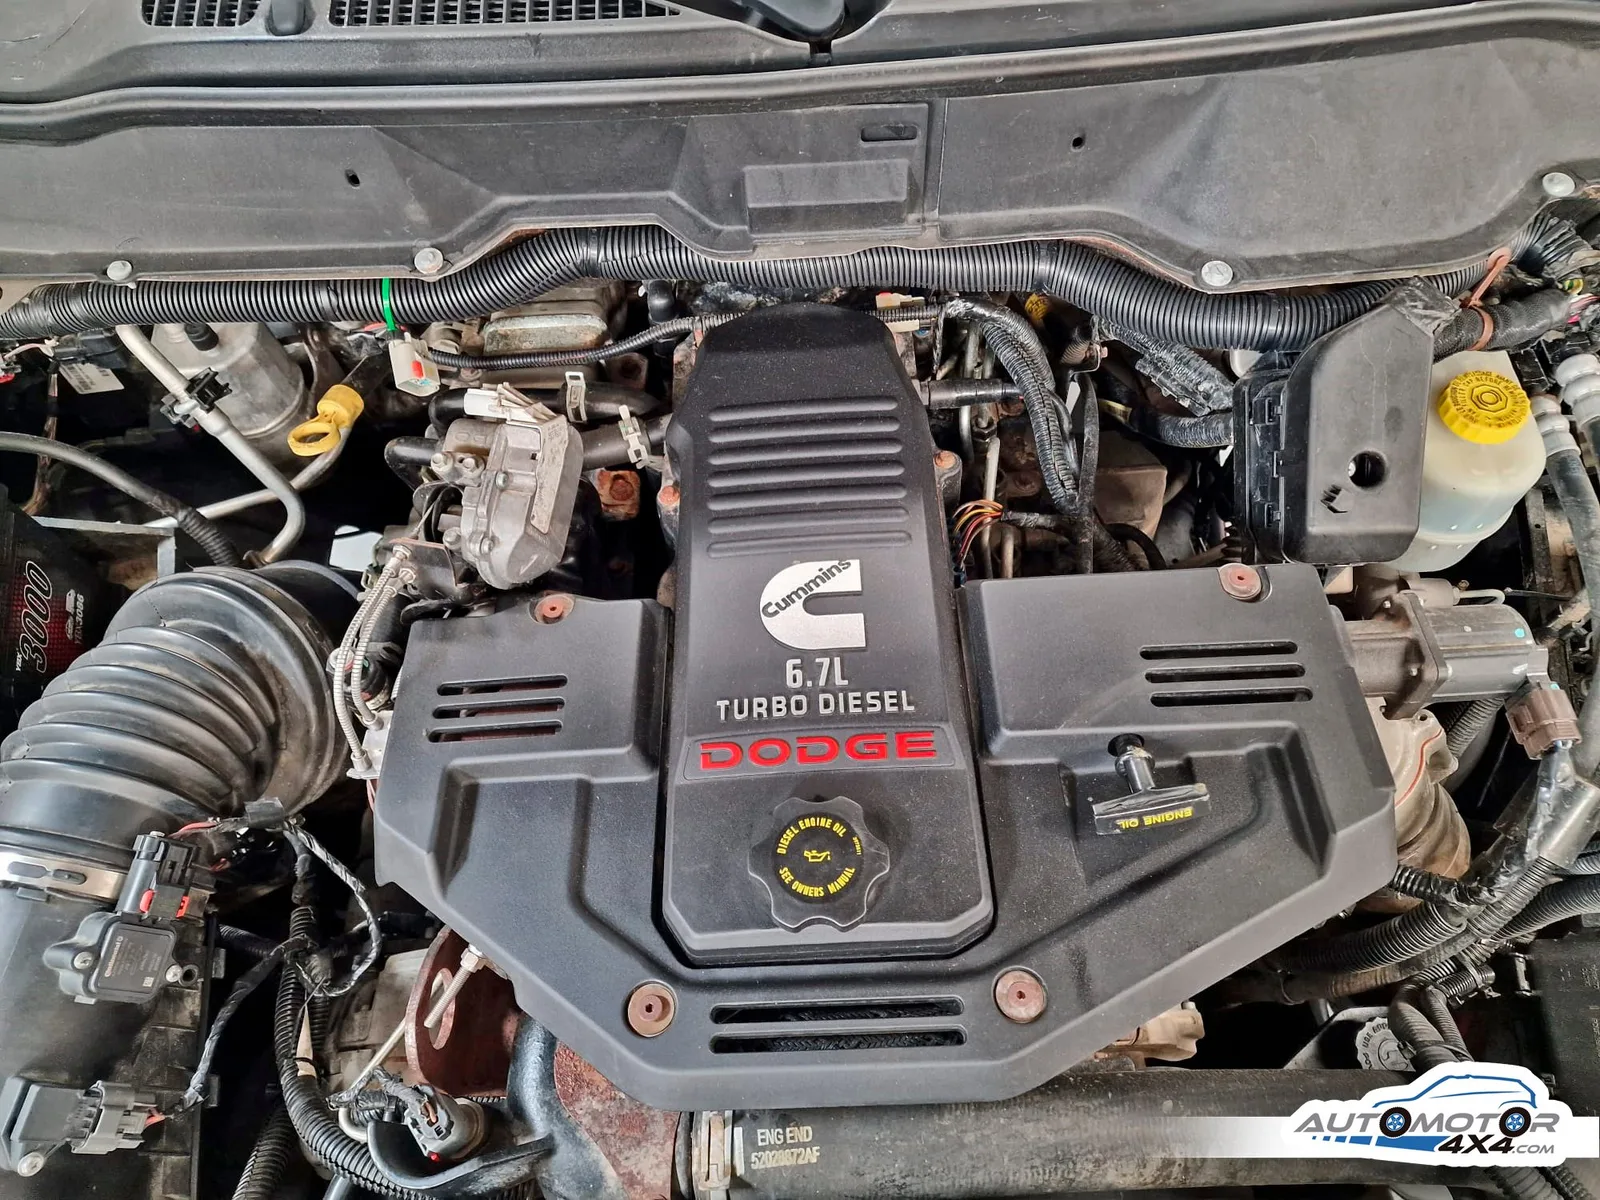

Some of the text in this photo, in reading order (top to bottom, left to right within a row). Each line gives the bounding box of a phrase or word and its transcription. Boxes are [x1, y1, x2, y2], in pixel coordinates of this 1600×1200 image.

[761, 559, 852, 618] Cummins
[20, 560, 52, 674] 3000
[785, 656, 849, 688] 6.7L
[716, 690, 916, 721] TURBO DIESEL
[700, 730, 938, 771] DODGE
[1115, 807, 1193, 829] ENGINE OIL
[776, 817, 847, 855] DIESEL ENGINE OIL
[779, 866, 856, 898] SEE OWNERS MANUAL
[757, 1125, 813, 1146] ENG END
